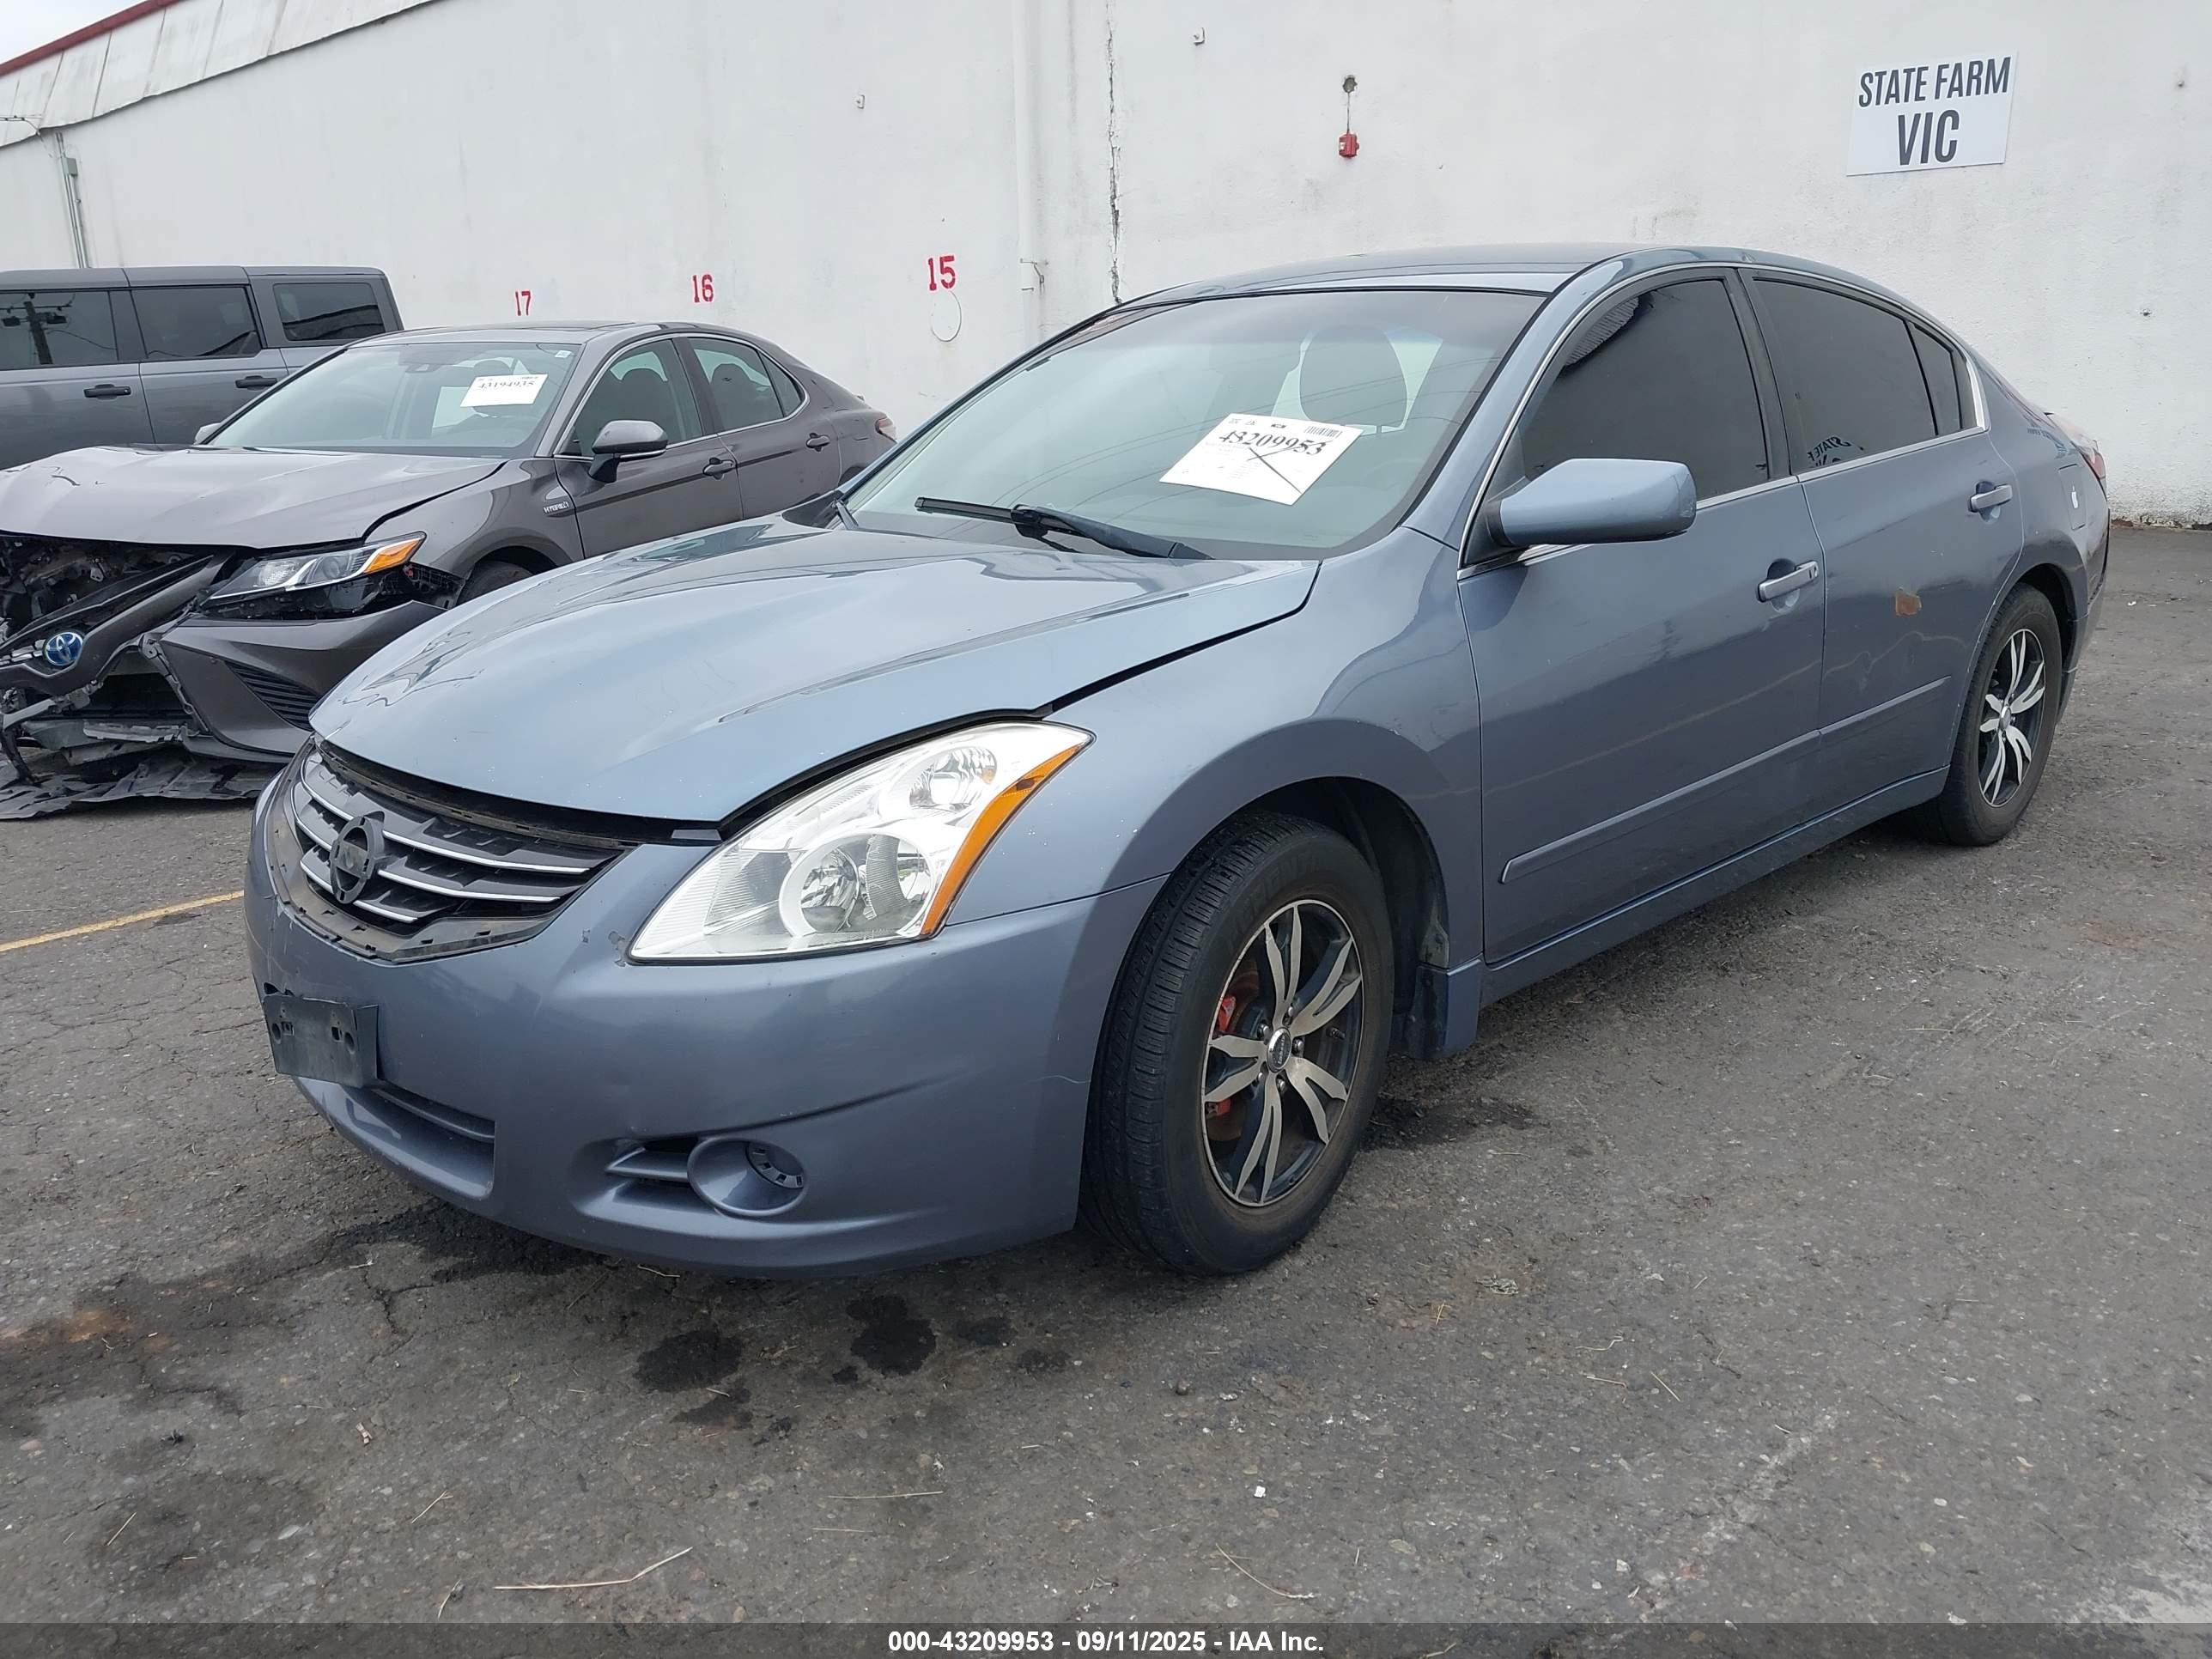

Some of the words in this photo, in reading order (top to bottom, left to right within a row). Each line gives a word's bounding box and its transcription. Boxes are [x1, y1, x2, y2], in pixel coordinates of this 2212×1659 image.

[1858, 65, 1929, 108] STATE
[1934, 56, 2012, 100] FARM
[1897, 109, 1960, 166] VIC
[691, 274, 714, 303] 16
[927, 255, 957, 292] 15
[514, 290, 532, 316] 17
[1218, 429, 1327, 456] 43209953
